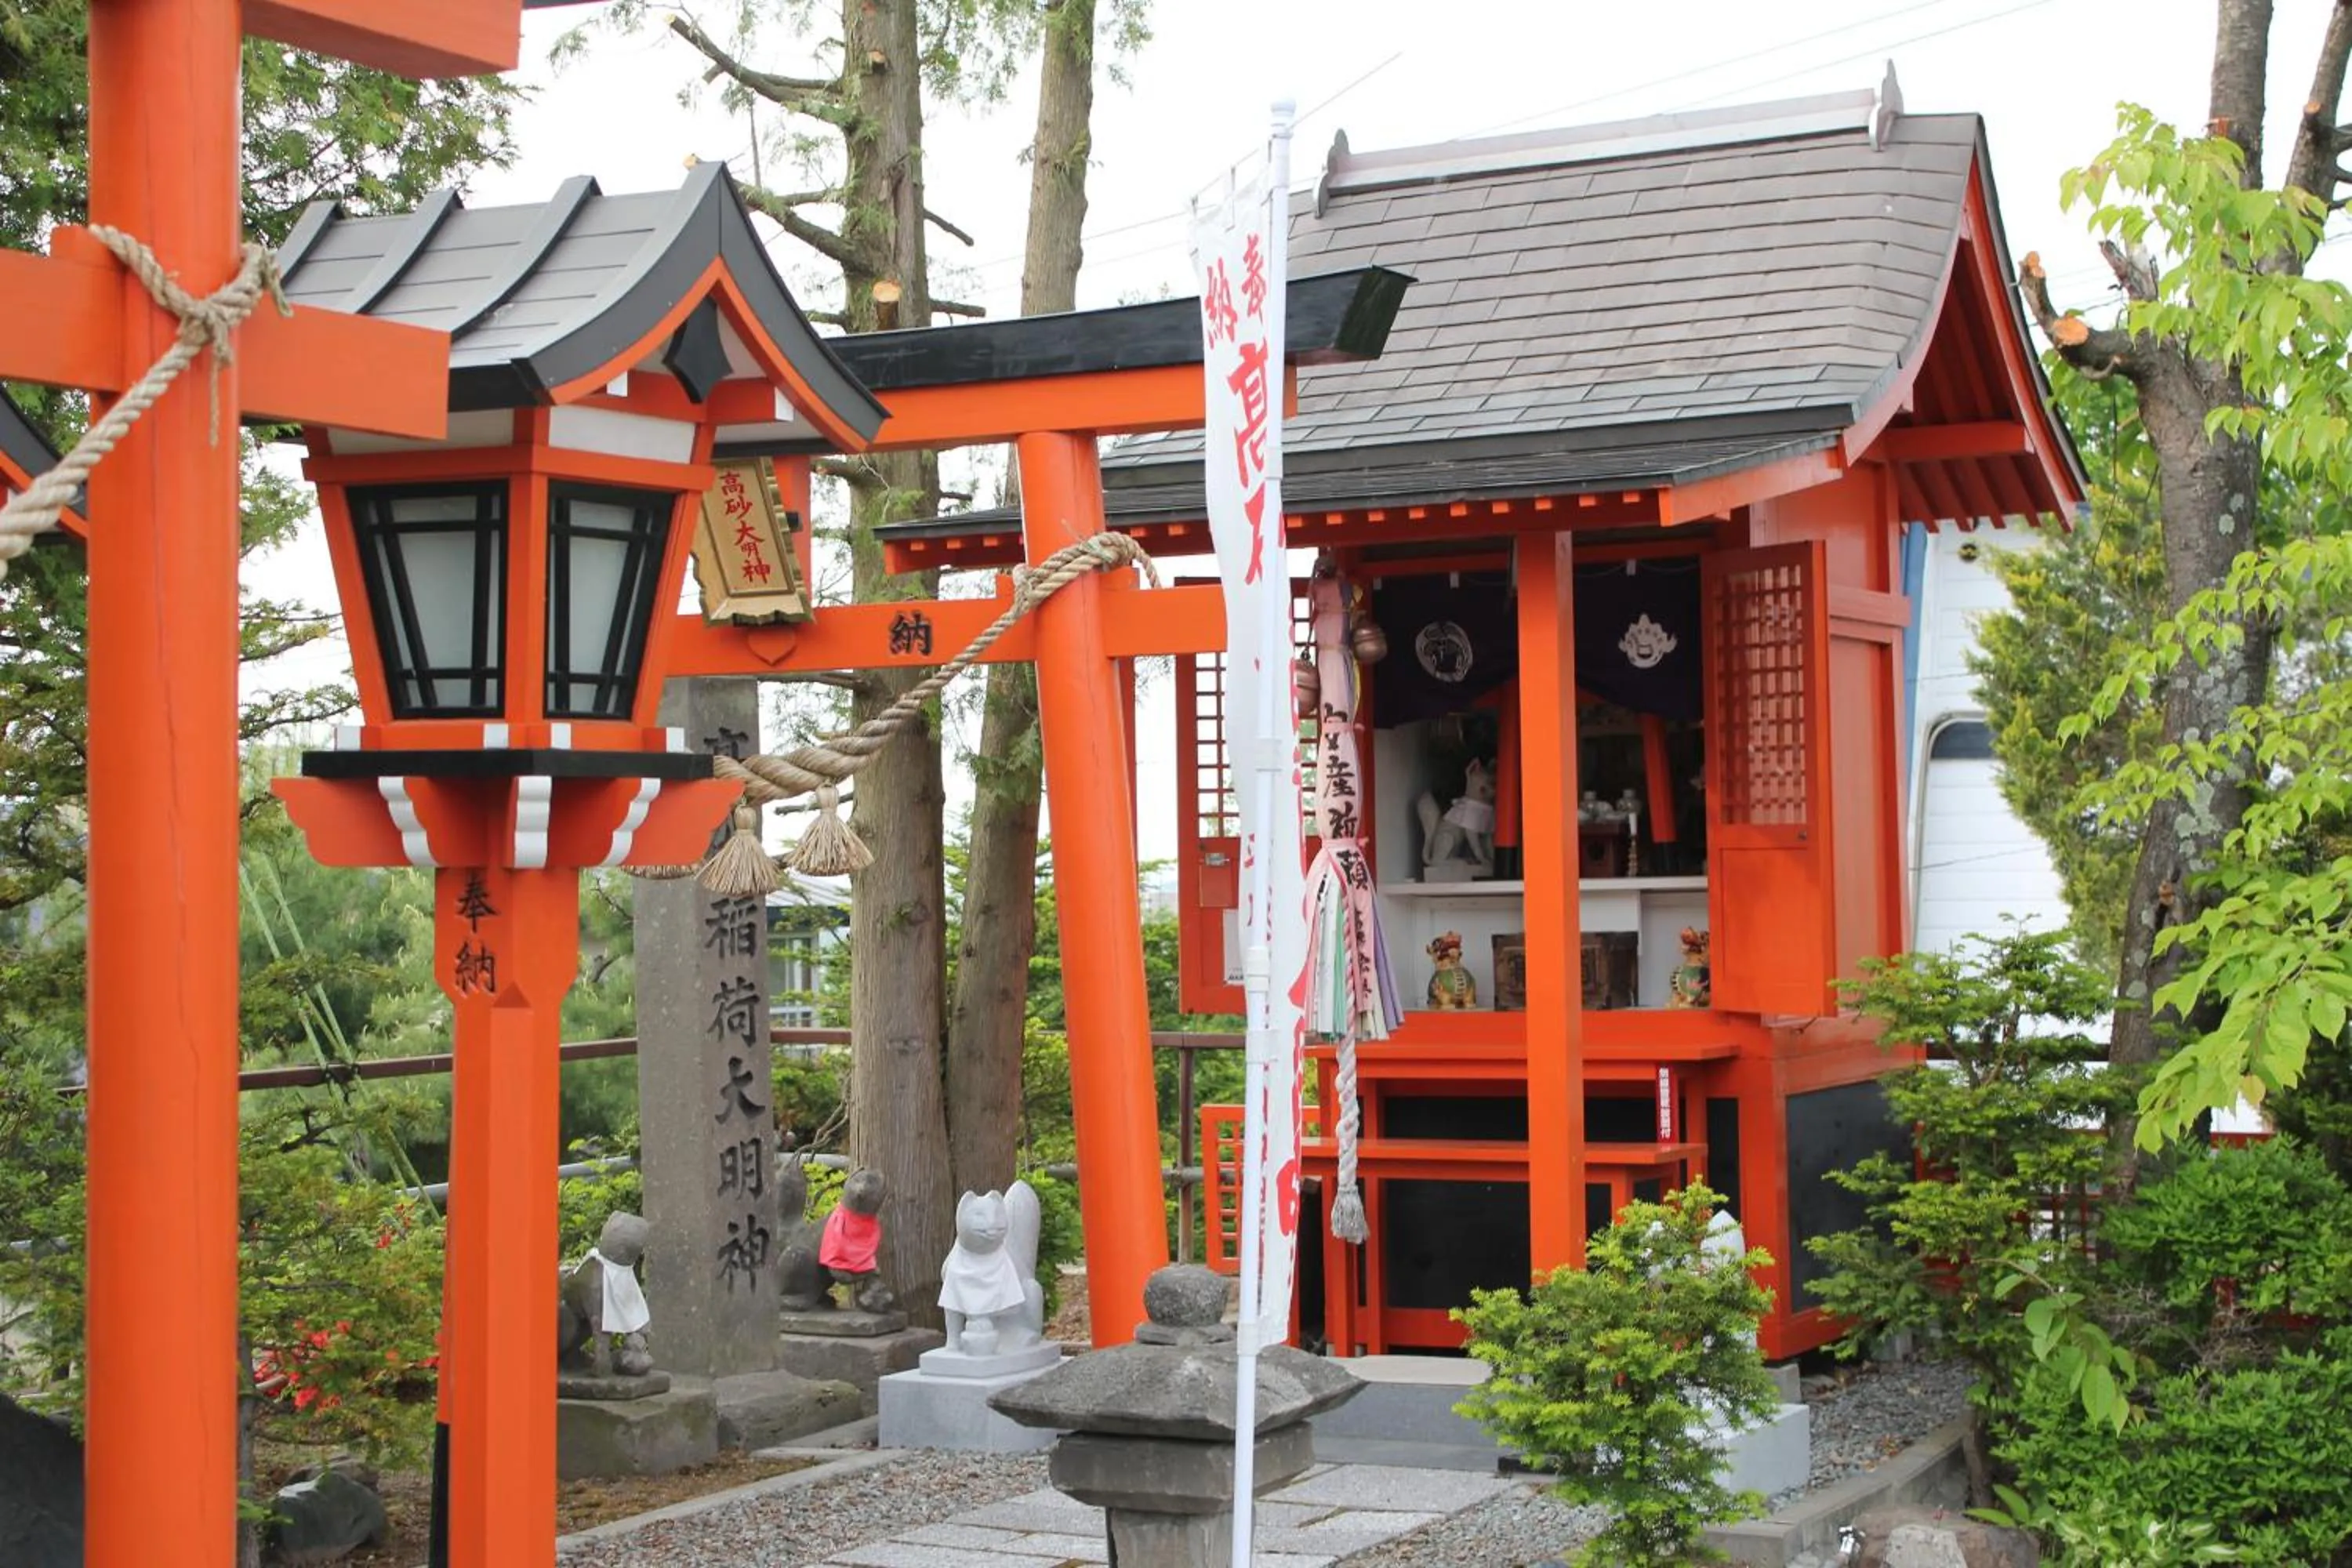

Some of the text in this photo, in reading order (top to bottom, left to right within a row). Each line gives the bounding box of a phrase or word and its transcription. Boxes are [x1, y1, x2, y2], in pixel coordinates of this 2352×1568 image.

[719, 472, 771, 584] 高砂大明神
[889, 612, 931, 656] 納
[455, 869, 501, 994] 奉納
[704, 727, 771, 1295] 稲荷大明神
